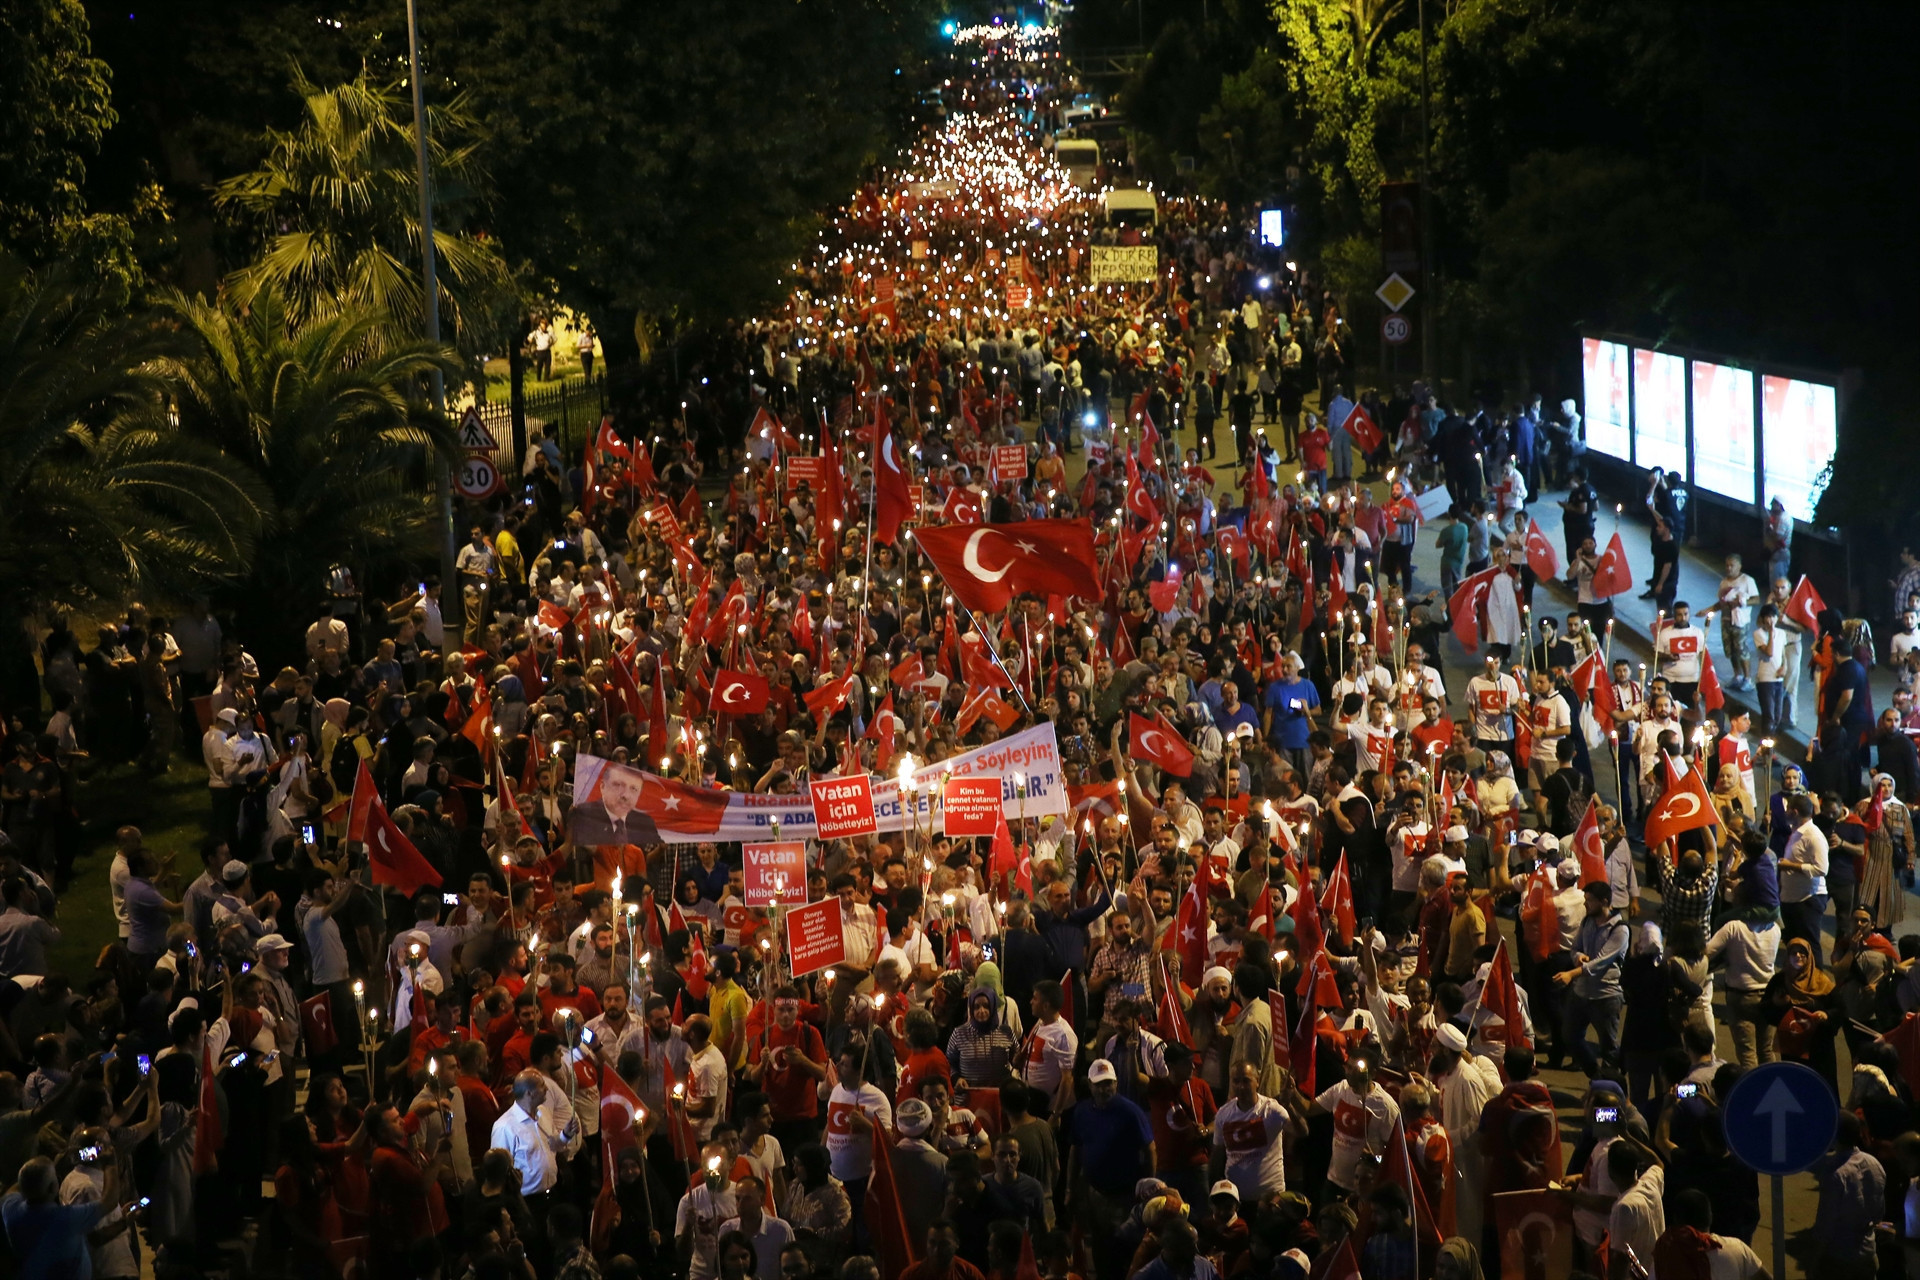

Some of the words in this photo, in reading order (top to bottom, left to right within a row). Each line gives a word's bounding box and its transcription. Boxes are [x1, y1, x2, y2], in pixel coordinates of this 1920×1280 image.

[1387, 321, 1406, 337] 50
[462, 466, 490, 488] 30
[976, 741, 1053, 771] Söyleyin;
[816, 785, 862, 802] Vatan
[829, 802, 857, 820] için
[945, 805, 970, 814] uğruna
[971, 804, 992, 812] olmaz
[820, 816, 873, 832] Nöbetteyiz!
[748, 850, 796, 865] Vatan
[760, 868, 789, 886] için
